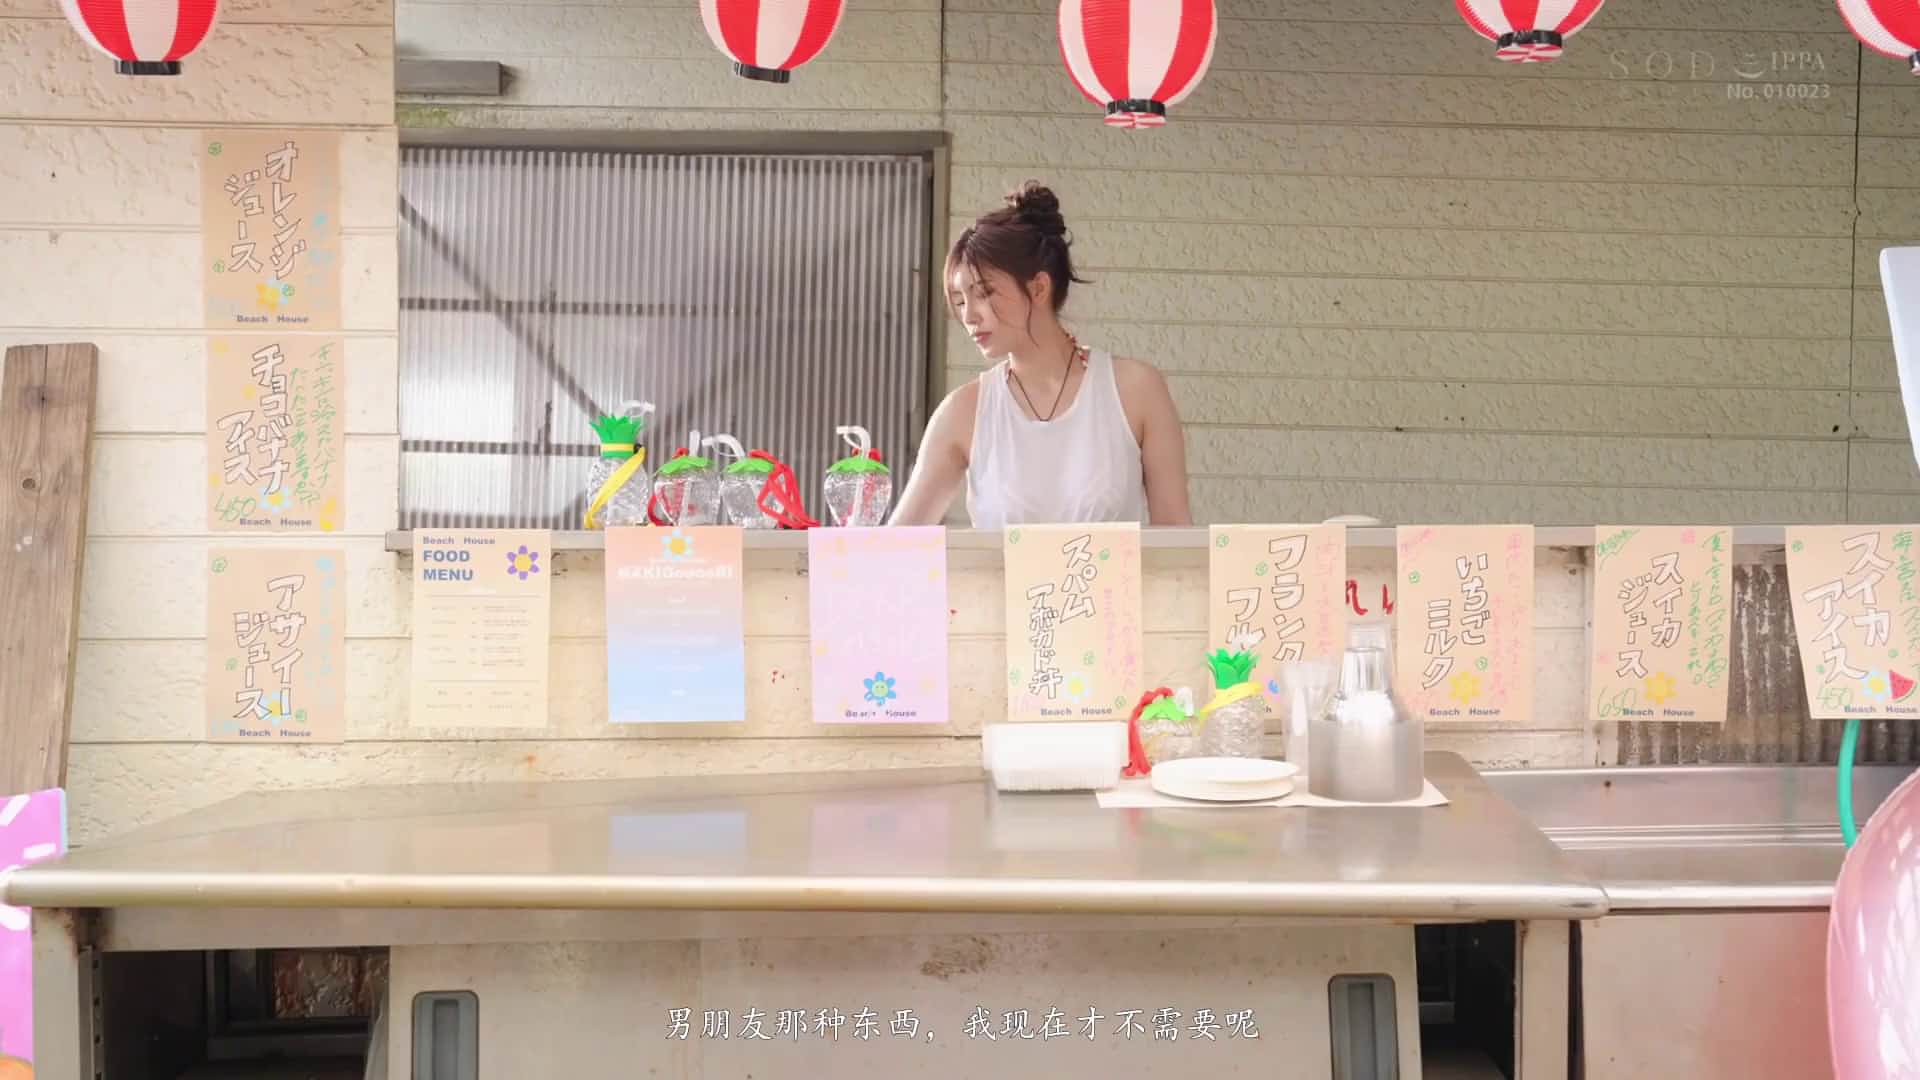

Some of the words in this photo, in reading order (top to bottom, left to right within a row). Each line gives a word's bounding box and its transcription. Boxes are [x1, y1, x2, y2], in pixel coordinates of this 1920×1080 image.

[224, 169, 265, 273] ジュース
[265, 141, 308, 280] オレンジ
[236, 314, 269, 323] Beach
[277, 314, 309, 323] House
[216, 410, 259, 486] アイス
[251, 343, 294, 496] チョコバナナ
[239, 518, 272, 526] Beach
[280, 518, 312, 526] House
[423, 535, 455, 545] Beach
[463, 535, 496, 545] House
[423, 550, 470, 562] FOOD
[423, 569, 474, 581] MENU
[1059, 534, 1098, 625] スパム
[1268, 534, 1308, 662] フランク
[1455, 553, 1491, 646] いちご
[1650, 552, 1685, 649] スイカ
[1841, 531, 1895, 647] スイカ
[233, 611, 273, 720] ジュース
[266, 574, 307, 716] アサイー
[1422, 598, 1458, 690] ミルク
[1616, 573, 1655, 680] ジュース
[1801, 578, 1868, 685] アイス
[239, 728, 271, 737] Beach
[280, 728, 312, 737] House
[1040, 707, 1072, 716] Beach
[1081, 707, 1113, 716] House
[1429, 708, 1460, 716] Beach
[1469, 708, 1501, 716] House
[1622, 708, 1654, 716] Beach
[1663, 708, 1695, 716] House
[1844, 704, 1877, 713] Beach
[1885, 704, 1919, 713] House
